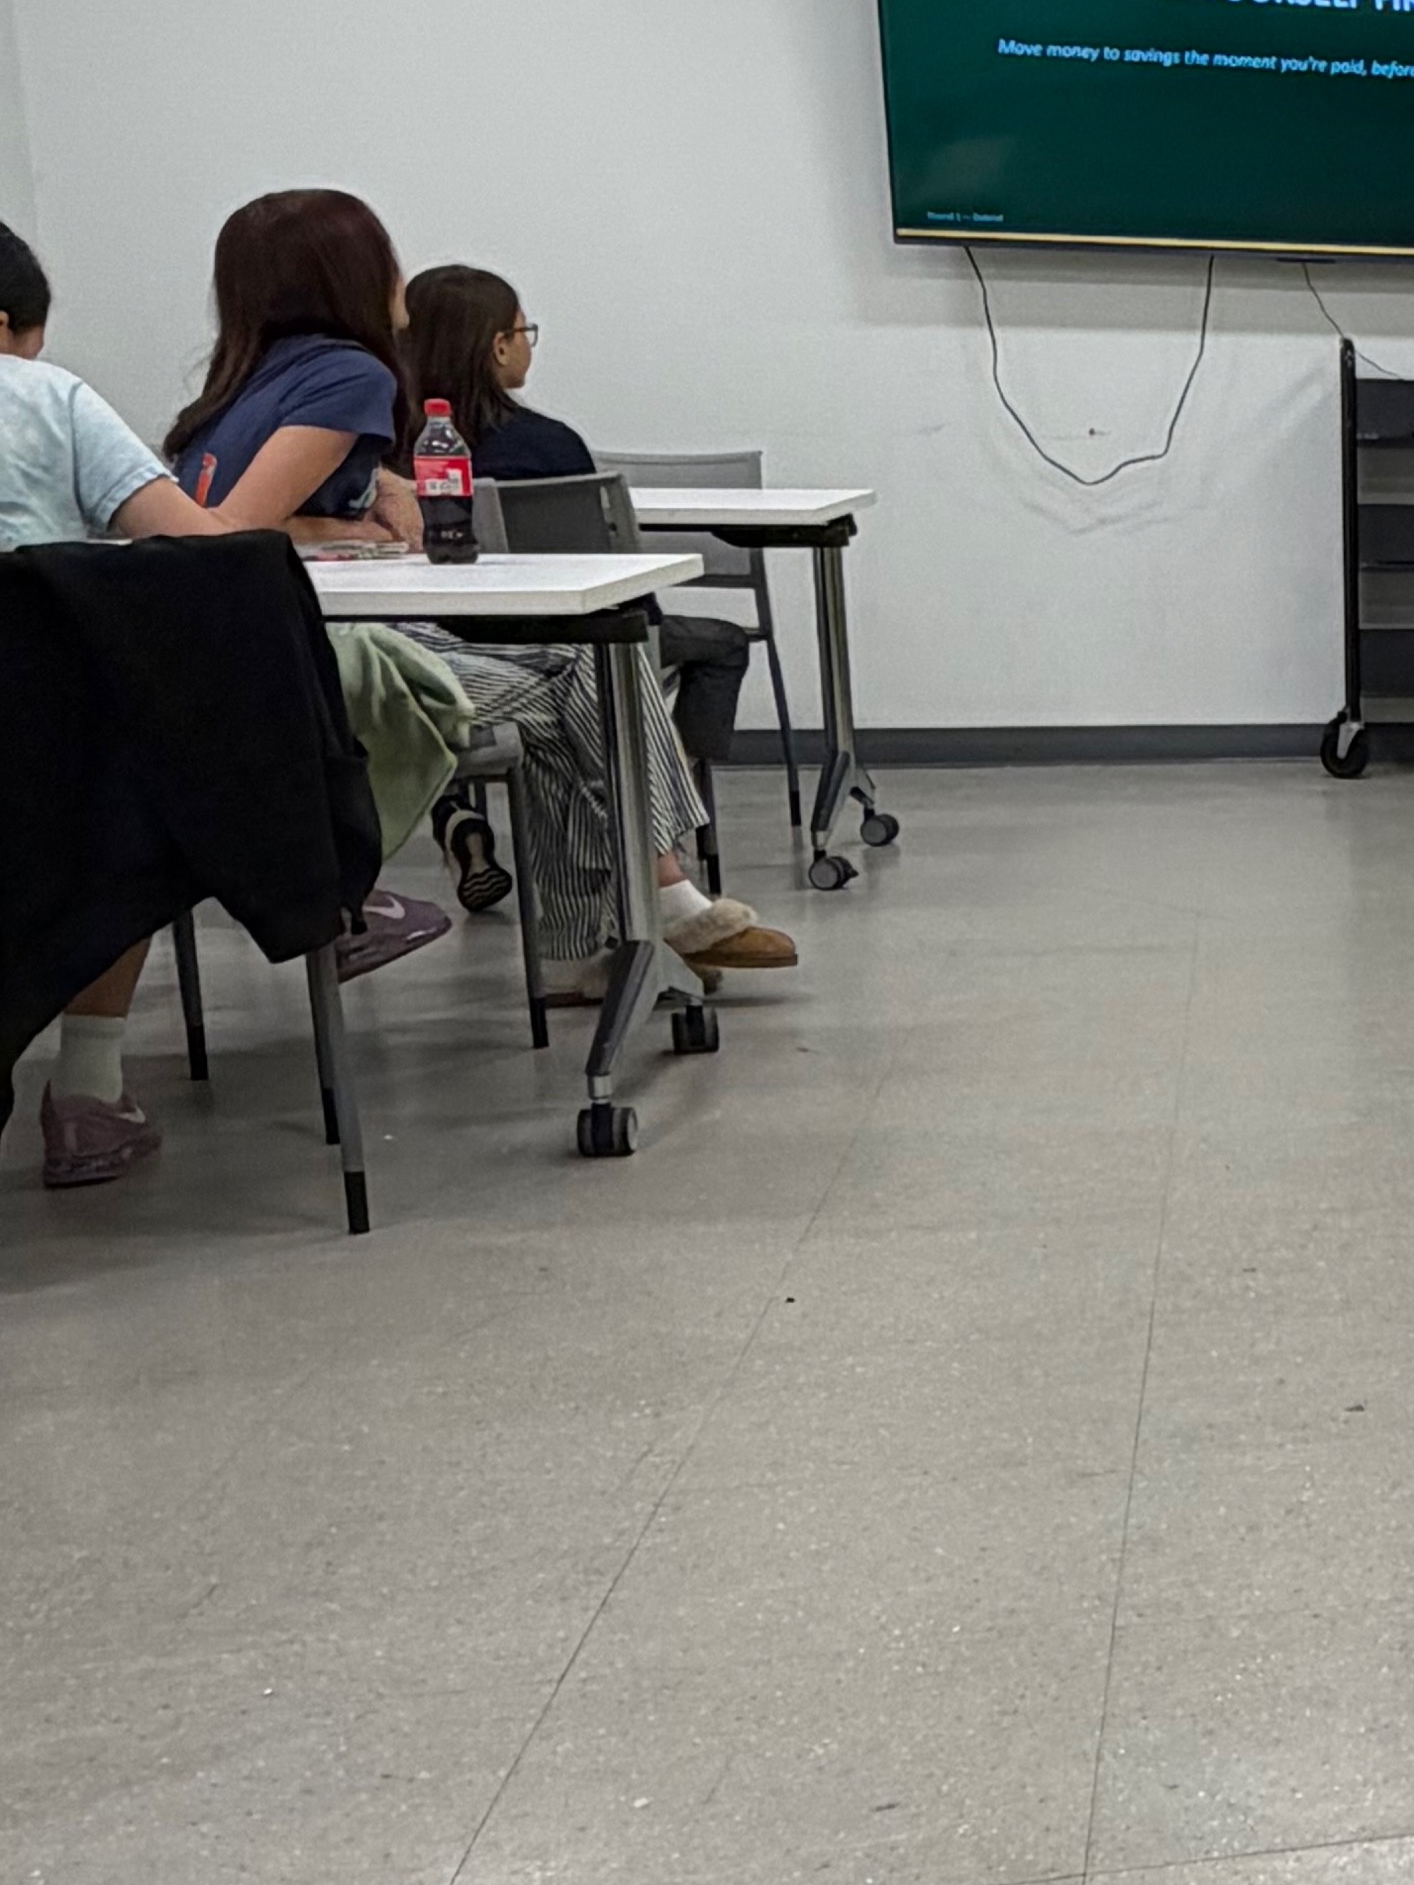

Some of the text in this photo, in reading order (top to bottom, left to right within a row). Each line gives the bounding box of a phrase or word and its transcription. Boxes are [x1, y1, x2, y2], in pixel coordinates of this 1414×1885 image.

[998, 38, 1043, 57] Move
[1046, 45, 1101, 62] money
[1104, 46, 1119, 61] to
[1124, 48, 1180, 67] savings
[1184, 50, 1210, 66] the
[1213, 54, 1278, 70] moment
[1280, 56, 1328, 74] you're
[1331, 57, 1367, 76] paid,
